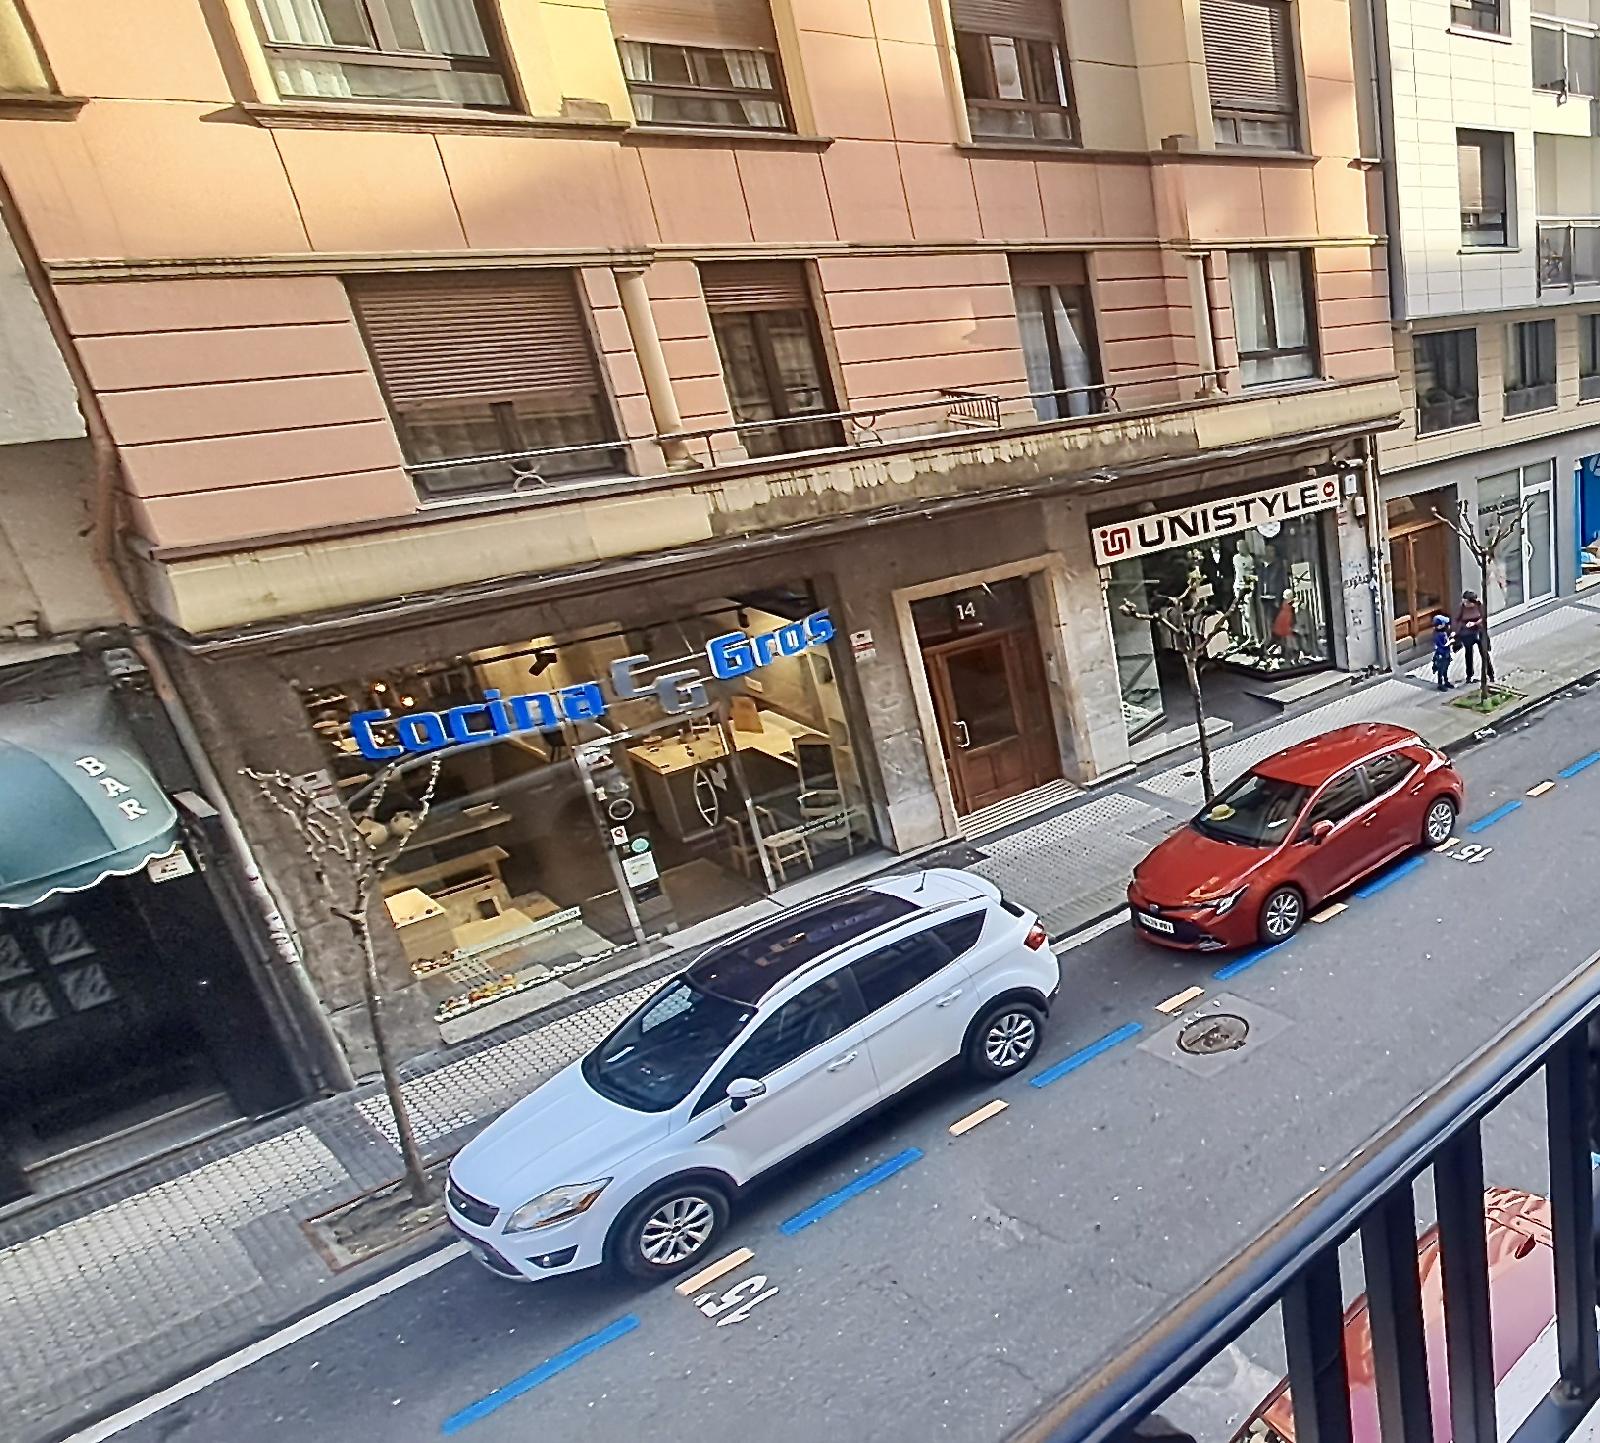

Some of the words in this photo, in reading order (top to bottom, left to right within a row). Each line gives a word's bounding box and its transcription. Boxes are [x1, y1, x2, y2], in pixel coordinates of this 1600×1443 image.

[1137, 484, 1319, 549] UNISTYLE
[956, 601, 975, 620] 14
[350, 681, 607, 759] Cocina
[705, 608, 837, 682] Gros
[74, 756, 148, 821] BAR
